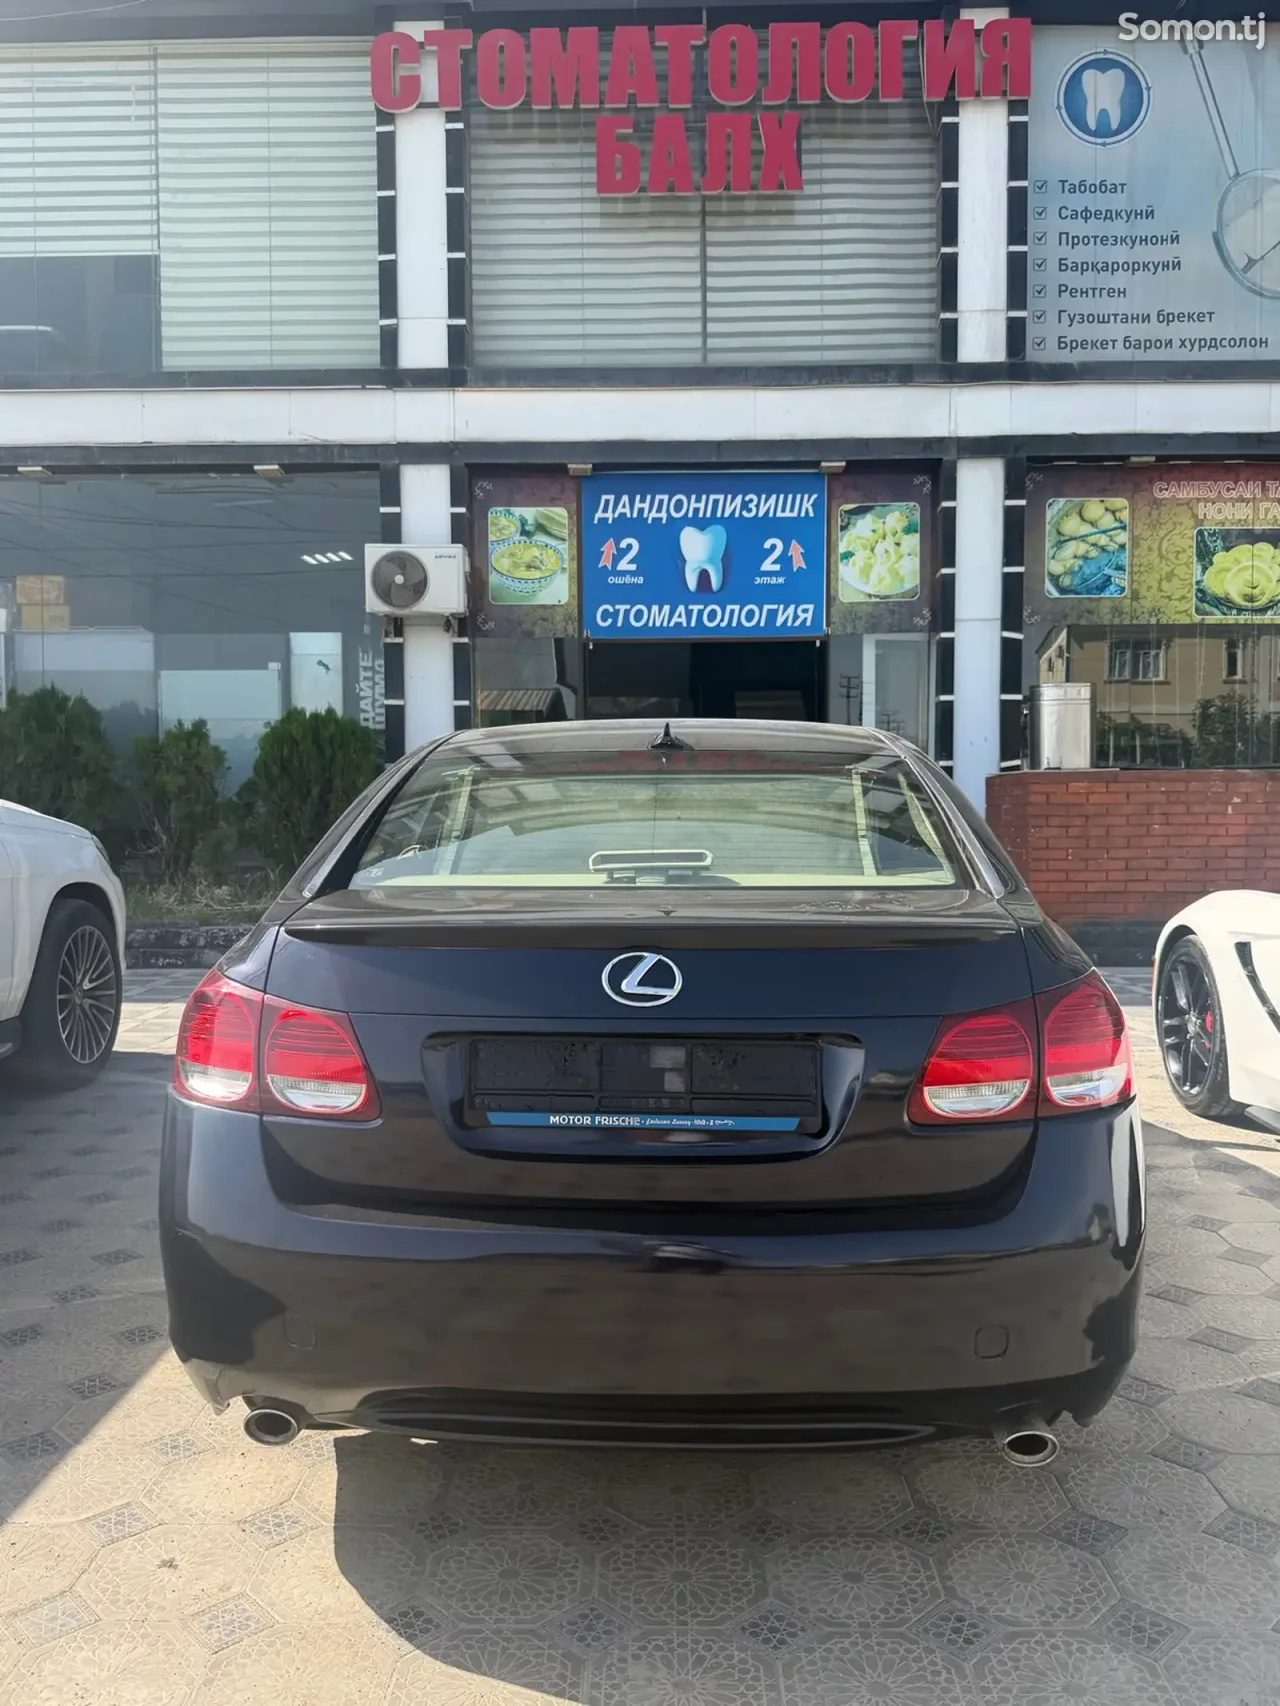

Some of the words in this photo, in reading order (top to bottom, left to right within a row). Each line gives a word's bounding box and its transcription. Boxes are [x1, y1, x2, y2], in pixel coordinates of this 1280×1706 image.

[370, 18, 1031, 113] СТОМАТОЛОГИЯ
[596, 112, 804, 197] БАЛХ
[1058, 179, 1127, 194] Табобат
[1058, 205, 1155, 223] Сафедкунӣ
[1058, 231, 1180, 249] Протезкунонӣ
[1058, 256, 1181, 275] Барқароркунӣ
[1058, 284, 1127, 298] Рентген
[1057, 310, 1151, 327] Гузоштани
[1156, 309, 1215, 326] брекет
[1057, 336, 1118, 353] Брекет
[1122, 335, 1173, 353] барои
[1178, 336, 1269, 352] хурдсолон
[1153, 481, 1261, 498] САМБУСАИ
[594, 493, 818, 524] ДАНДОНПИЗИШК
[1198, 502, 1253, 519] НОНИ
[616, 537, 640, 571] 2
[760, 537, 784, 571] 2
[608, 574, 644, 584] ошёна
[754, 575, 786, 585] этаж
[596, 604, 814, 627] СТОМАТОЛОГИЯ
[550, 1115, 591, 1125] MOTOR
